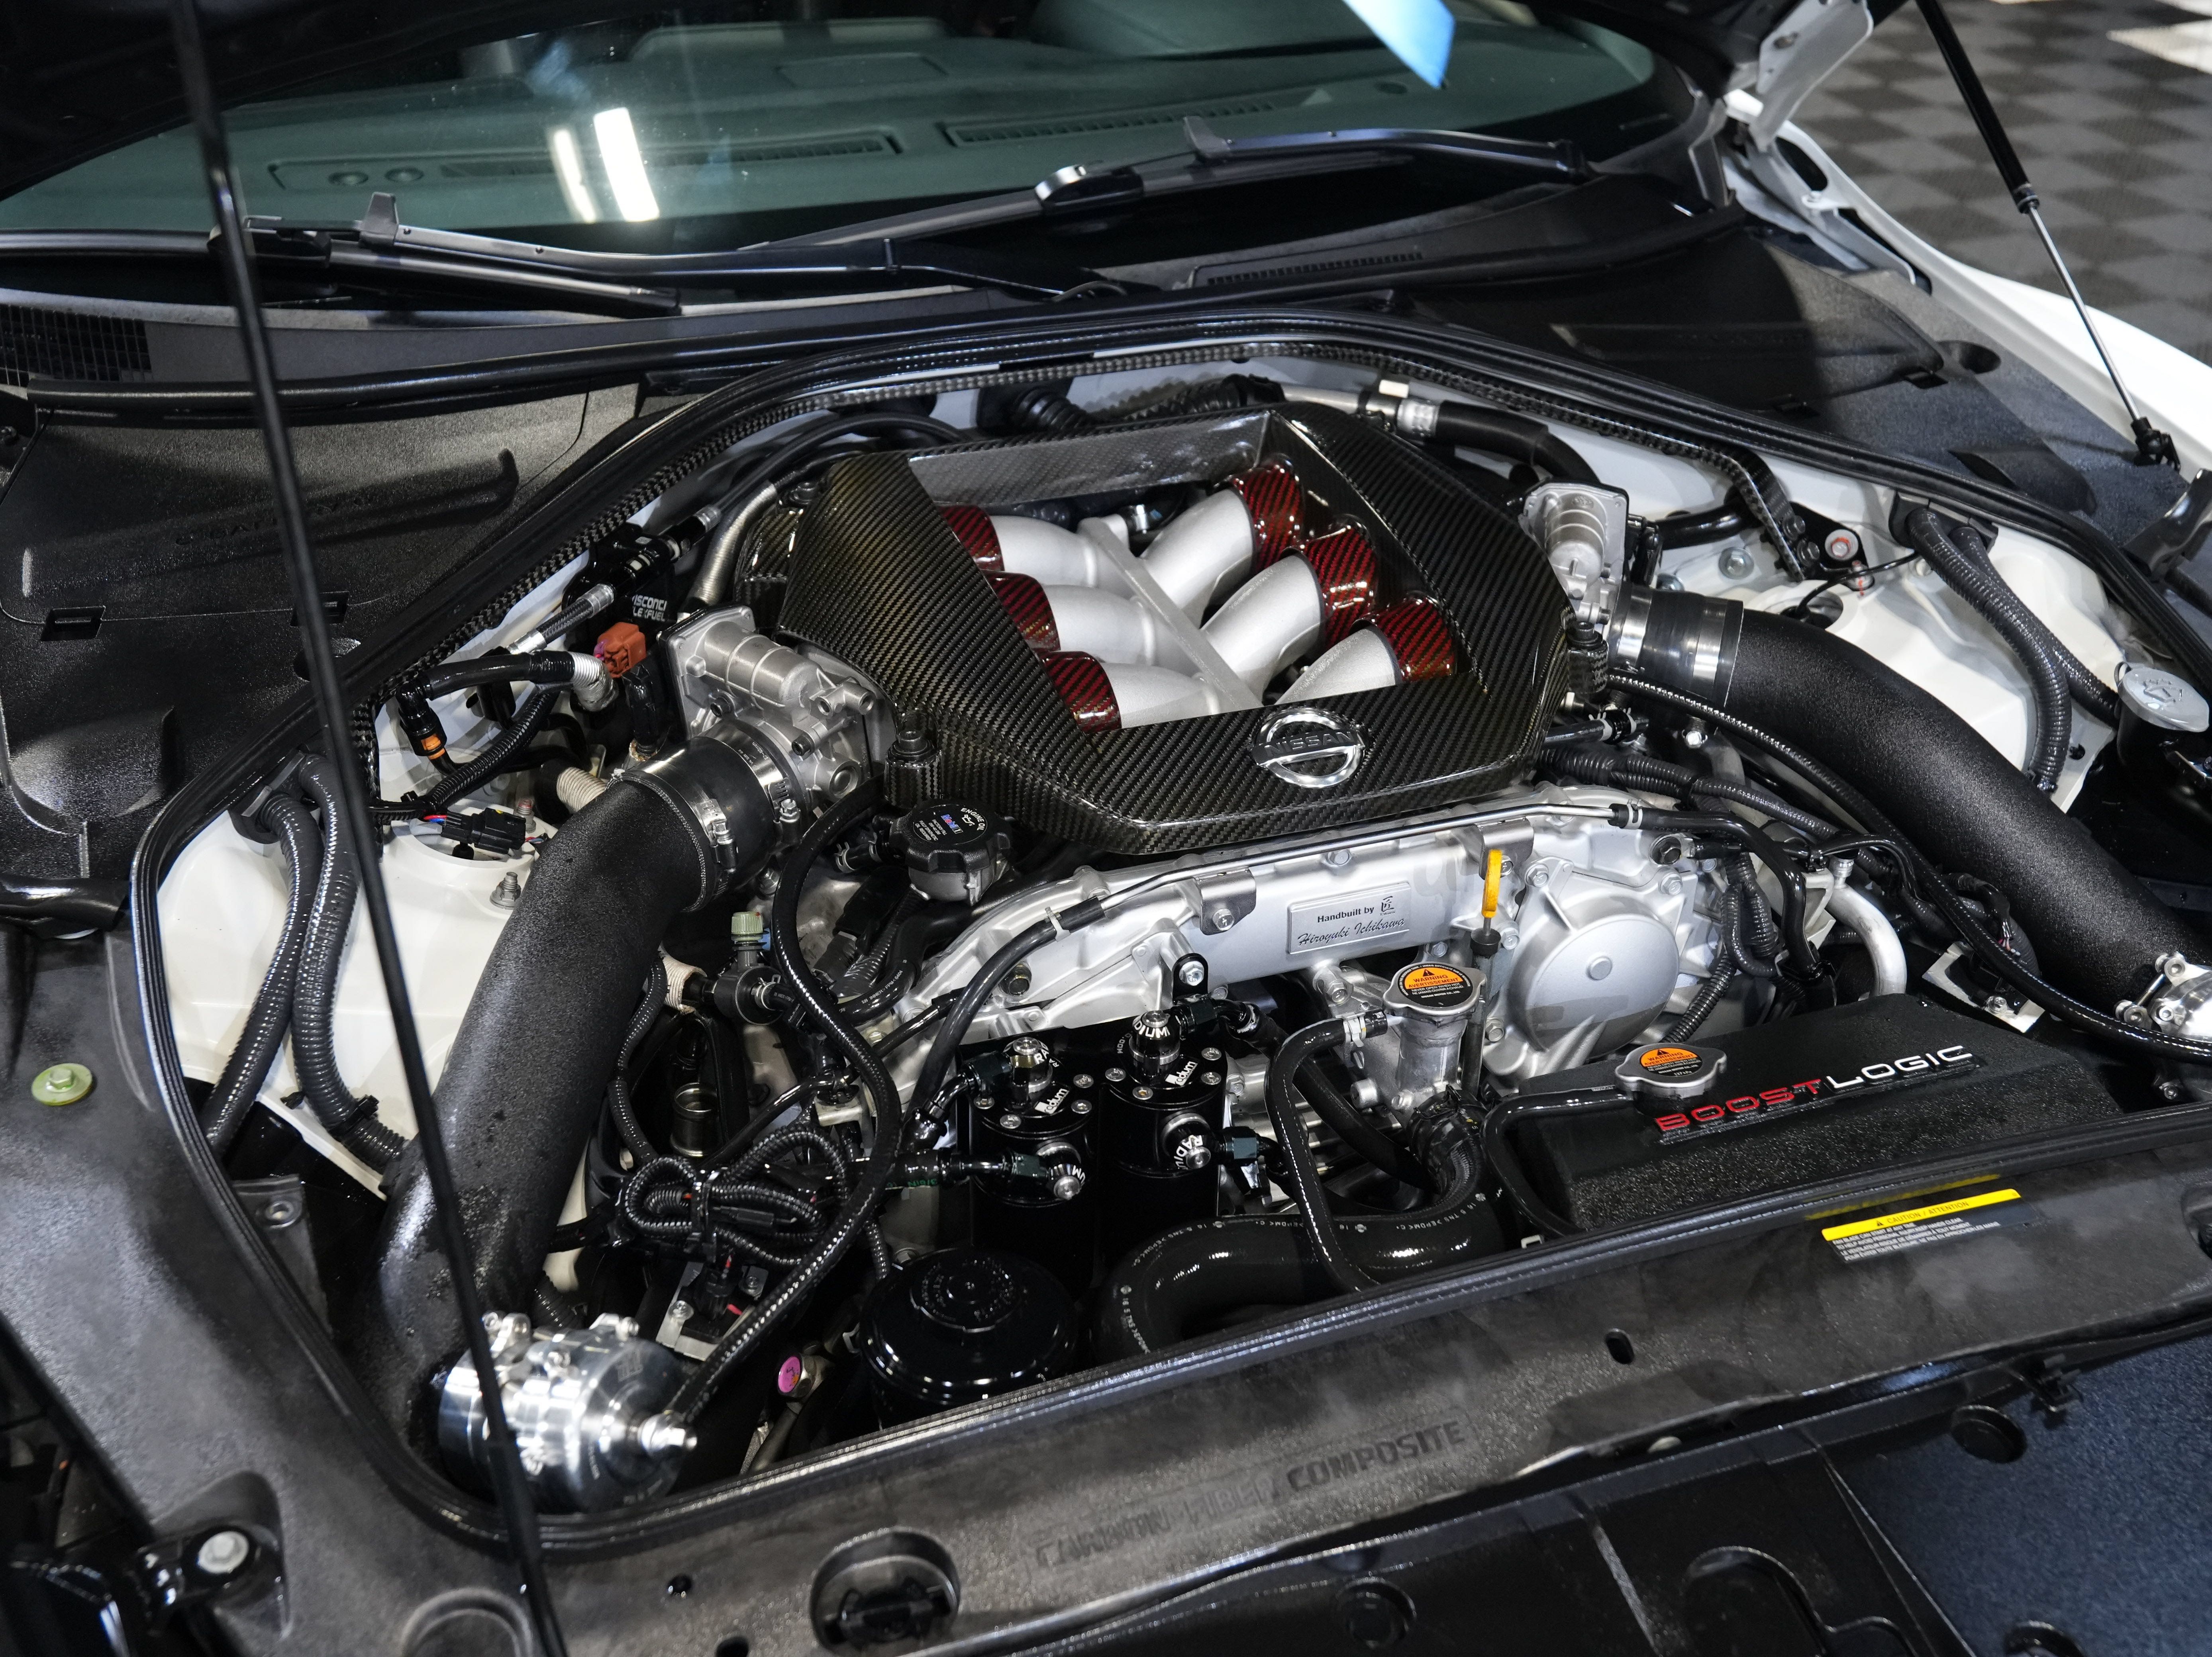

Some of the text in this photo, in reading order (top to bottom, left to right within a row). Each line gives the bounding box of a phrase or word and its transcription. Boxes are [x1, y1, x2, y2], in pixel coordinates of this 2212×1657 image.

[1264, 731, 1355, 756] NISSAN
[941, 814, 959, 830] Mobil
[961, 807, 984, 823] ENGINE
[931, 819, 944, 830] FACTORY
[919, 828, 932, 840] REQUIRED
[924, 827, 938, 841] SYNTHETIC
[1317, 907, 1375, 923] Handbuilt by
[1297, 918, 1405, 946] Hiroyuki Ichikawa
[1408, 977, 1458, 988] AVERTISSEMENT
[1413, 974, 1448, 983] WARNING
[1644, 1054, 1693, 1065] AVERTISSEMENT
[1648, 1052, 1684, 1061] WARNING
[1655, 1045, 1973, 1131] BOOSTLOGIC
[1886, 1212, 1921, 1224] CAUTION
[1928, 1201, 1969, 1214] ATTENTION
[1285, 1419, 1467, 1492] COMPOSITE
